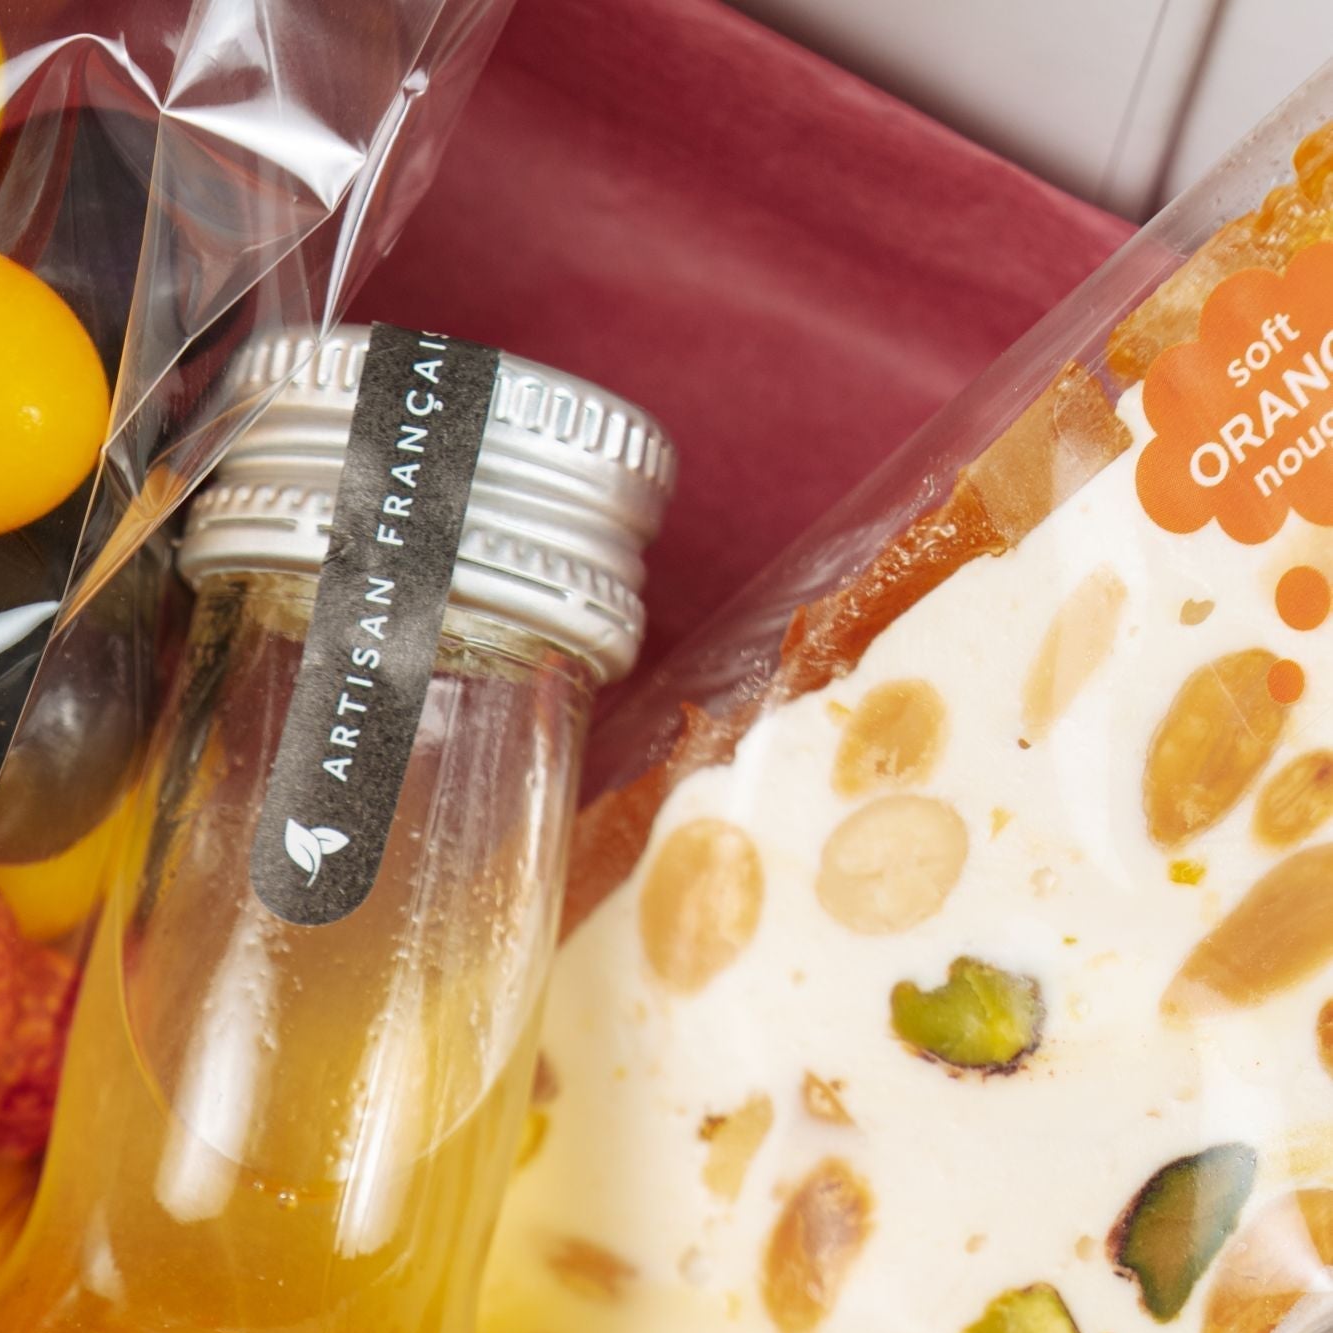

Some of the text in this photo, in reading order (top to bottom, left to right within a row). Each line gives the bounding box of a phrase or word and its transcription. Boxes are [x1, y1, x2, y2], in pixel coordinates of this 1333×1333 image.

[1226, 312, 1300, 388] soft
[321, 330, 450, 782] ARTISAN FRANÇAI
